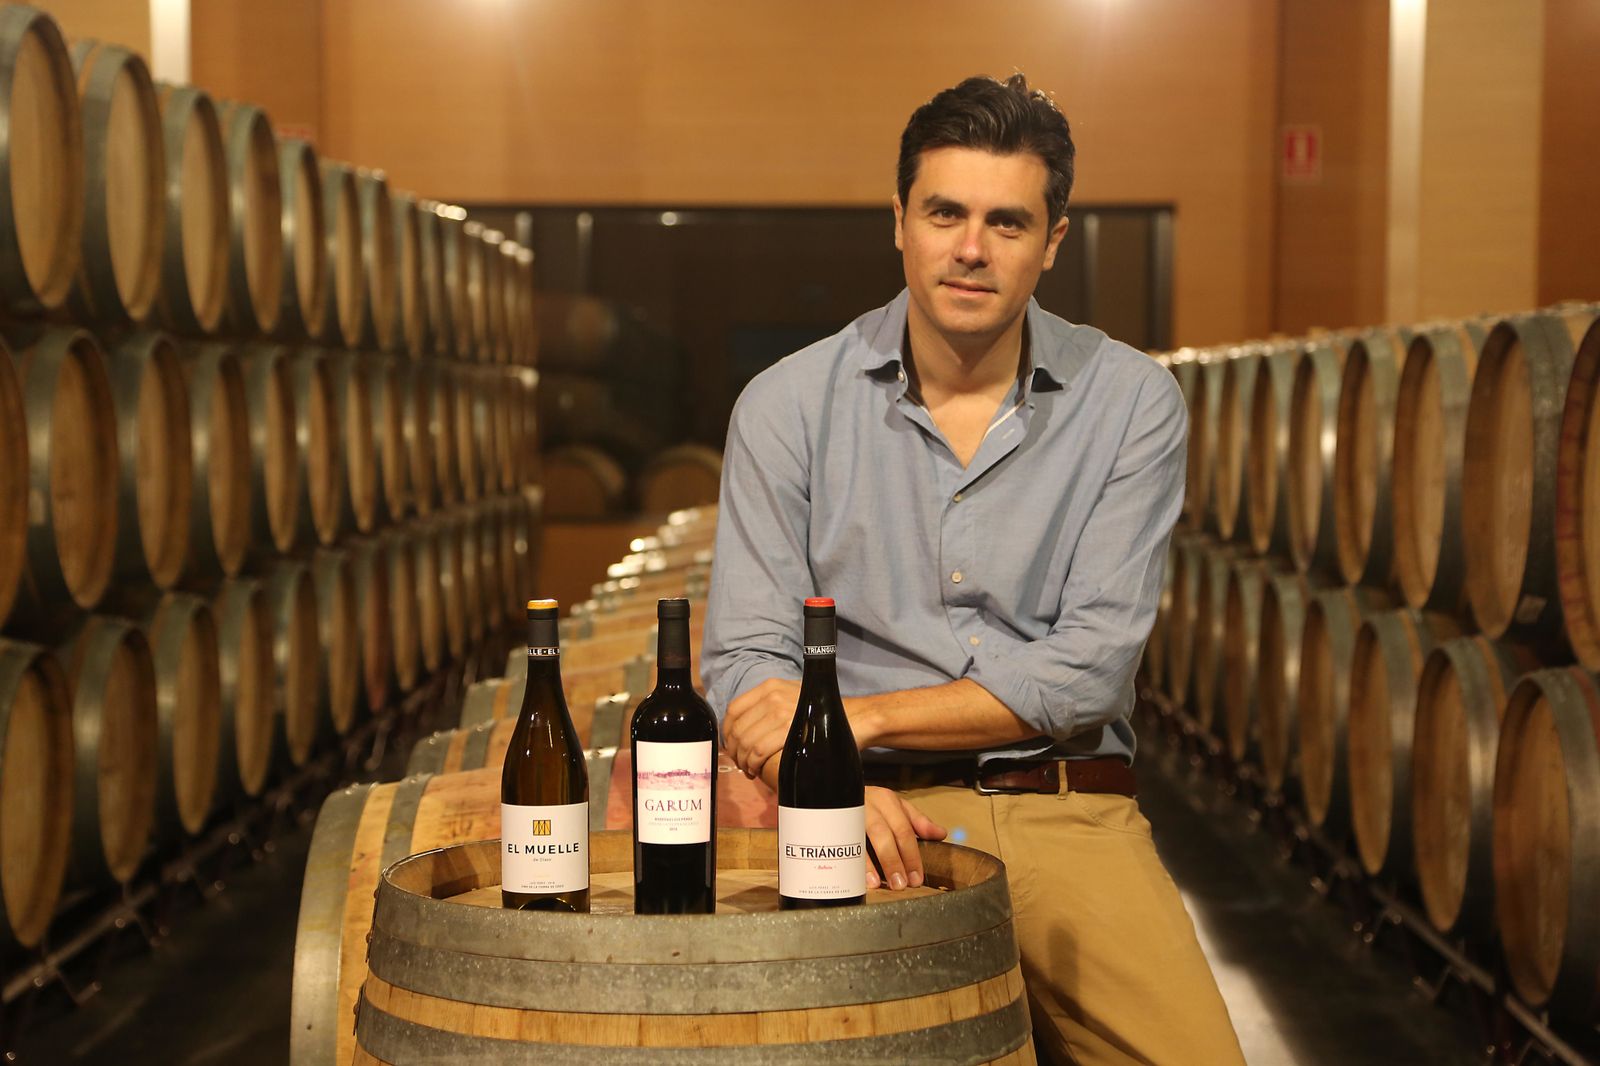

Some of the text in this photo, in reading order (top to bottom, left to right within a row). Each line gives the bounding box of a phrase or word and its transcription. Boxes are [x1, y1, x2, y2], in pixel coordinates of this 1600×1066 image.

[645, 798, 702, 811] GARUM
[507, 842, 579, 855] EL MUELLE
[785, 845, 862, 858] EL TRIÁNGULO
